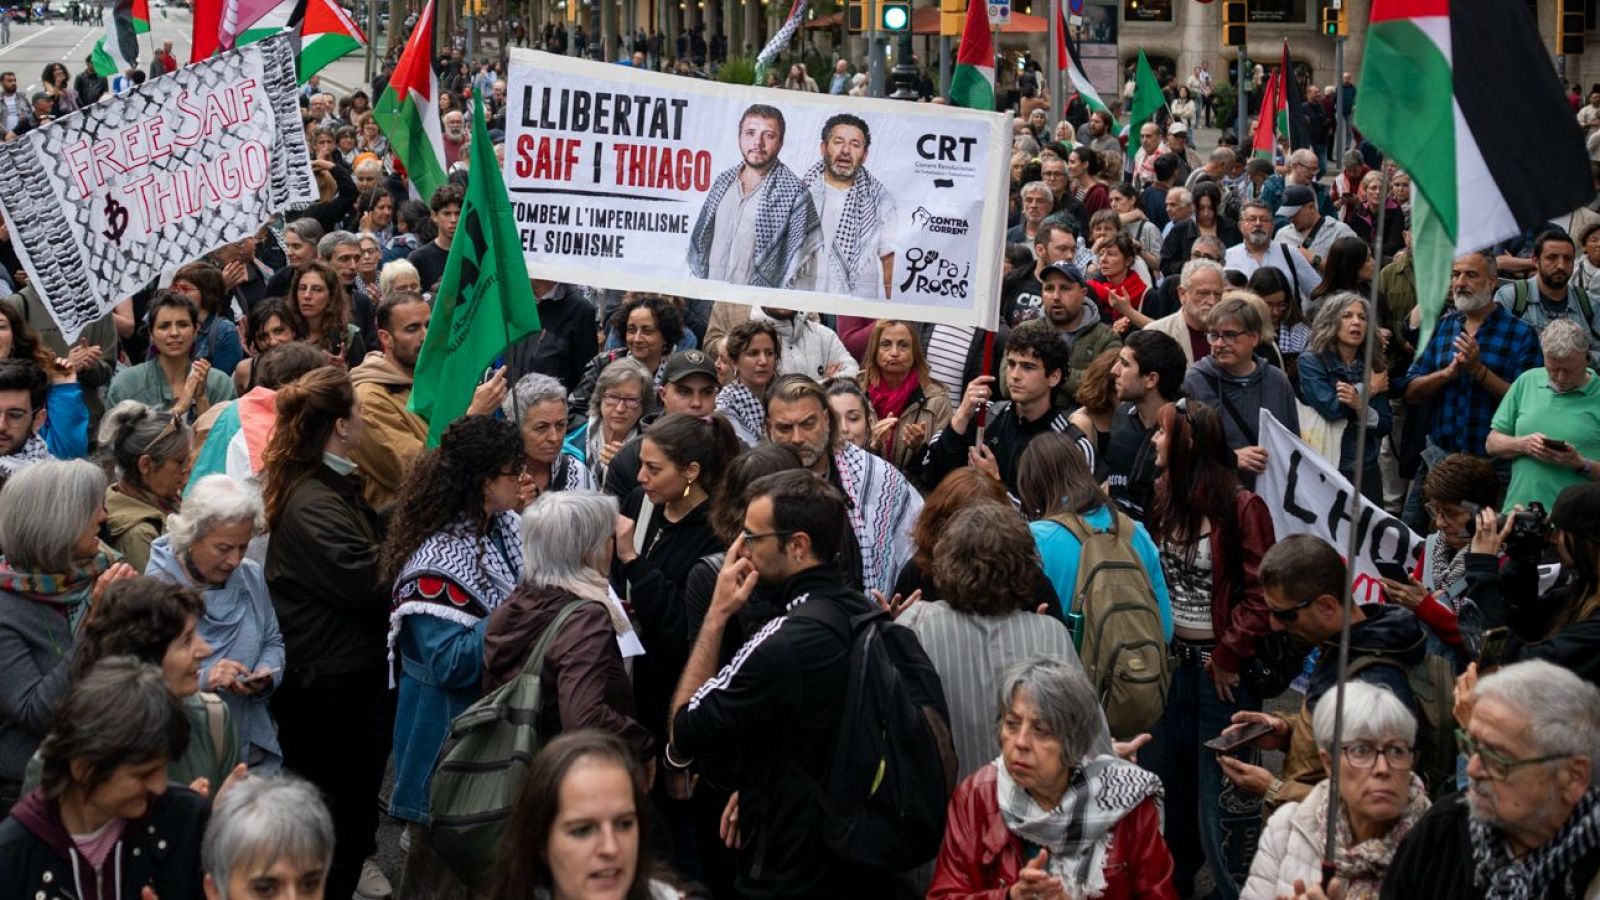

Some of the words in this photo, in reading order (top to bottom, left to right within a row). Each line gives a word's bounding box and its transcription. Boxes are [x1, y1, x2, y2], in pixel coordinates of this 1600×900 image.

[521, 85, 688, 141] LLIBERTAT
[62, 115, 173, 199] FREE
[174, 79, 256, 147] SAIF
[916, 133, 977, 163] CRT
[515, 133, 582, 182] SAIF
[593, 141, 603, 184] I
[613, 143, 712, 192] THIAGO
[123, 139, 269, 234] THIAGO
[576, 206, 689, 234] L'IMPERIALISME
[929, 225, 968, 235] CORRENT
[930, 216, 969, 228] CONTRA
[521, 229, 538, 253] EL
[544, 231, 625, 258] SIONISME
[1284, 450, 1425, 573] L'HO
